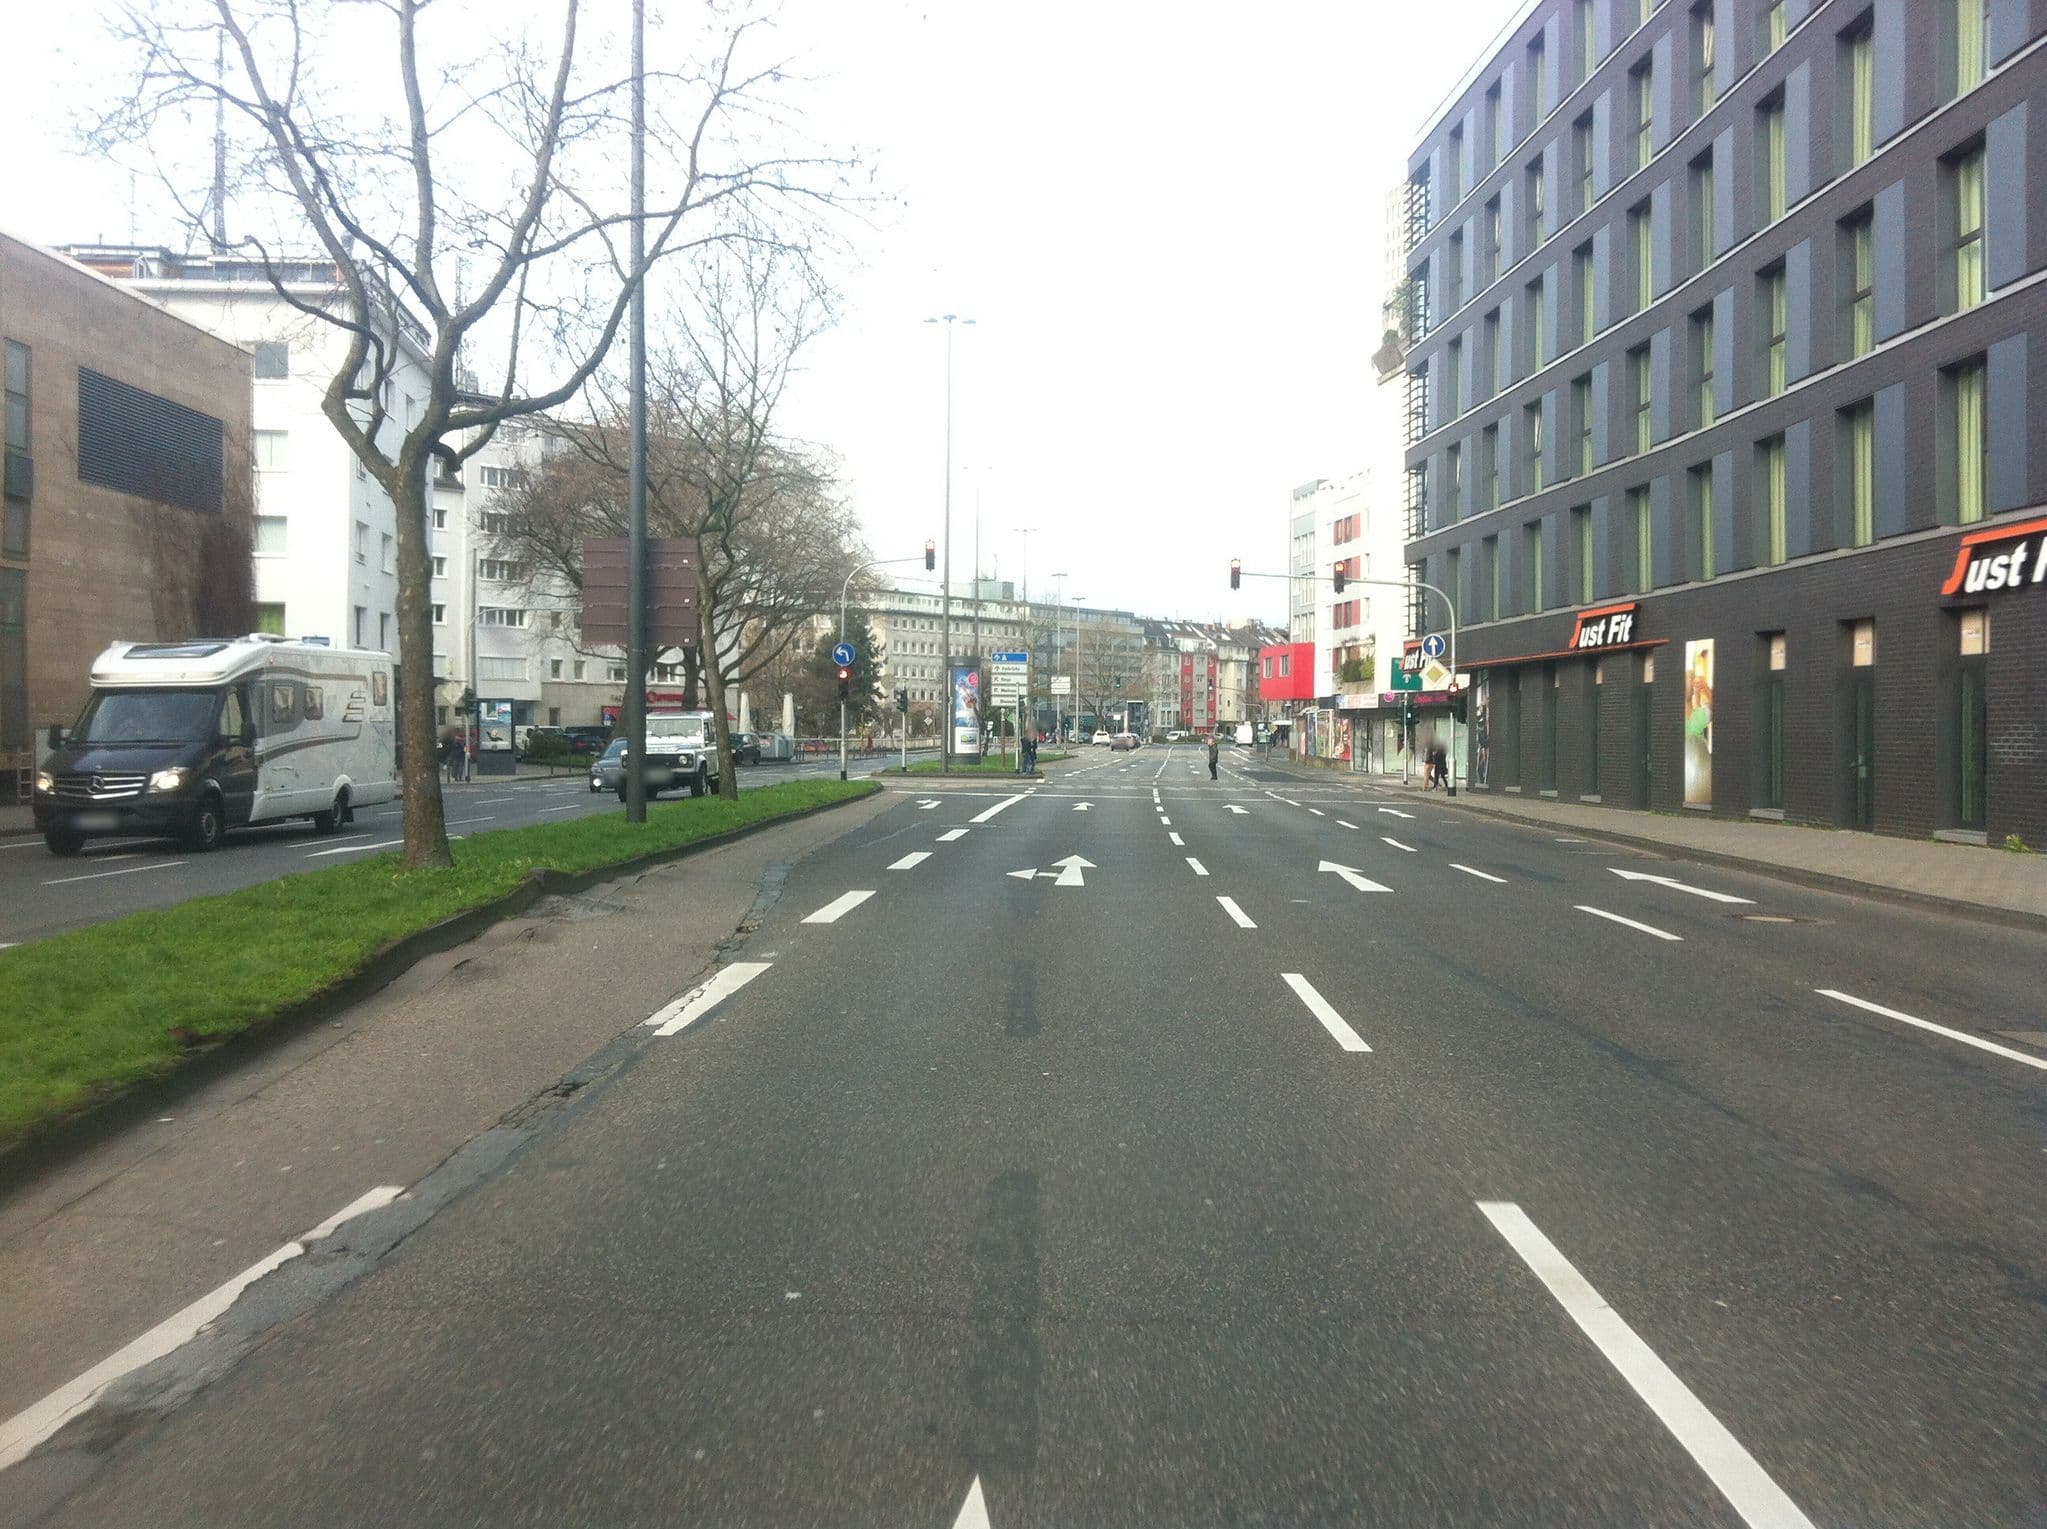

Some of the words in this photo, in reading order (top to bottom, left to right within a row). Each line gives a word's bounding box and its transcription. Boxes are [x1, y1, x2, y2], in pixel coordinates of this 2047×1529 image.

[1941, 536, 2028, 596] Just
[1569, 612, 1606, 649] Just
[1607, 614, 1633, 644] Fit
